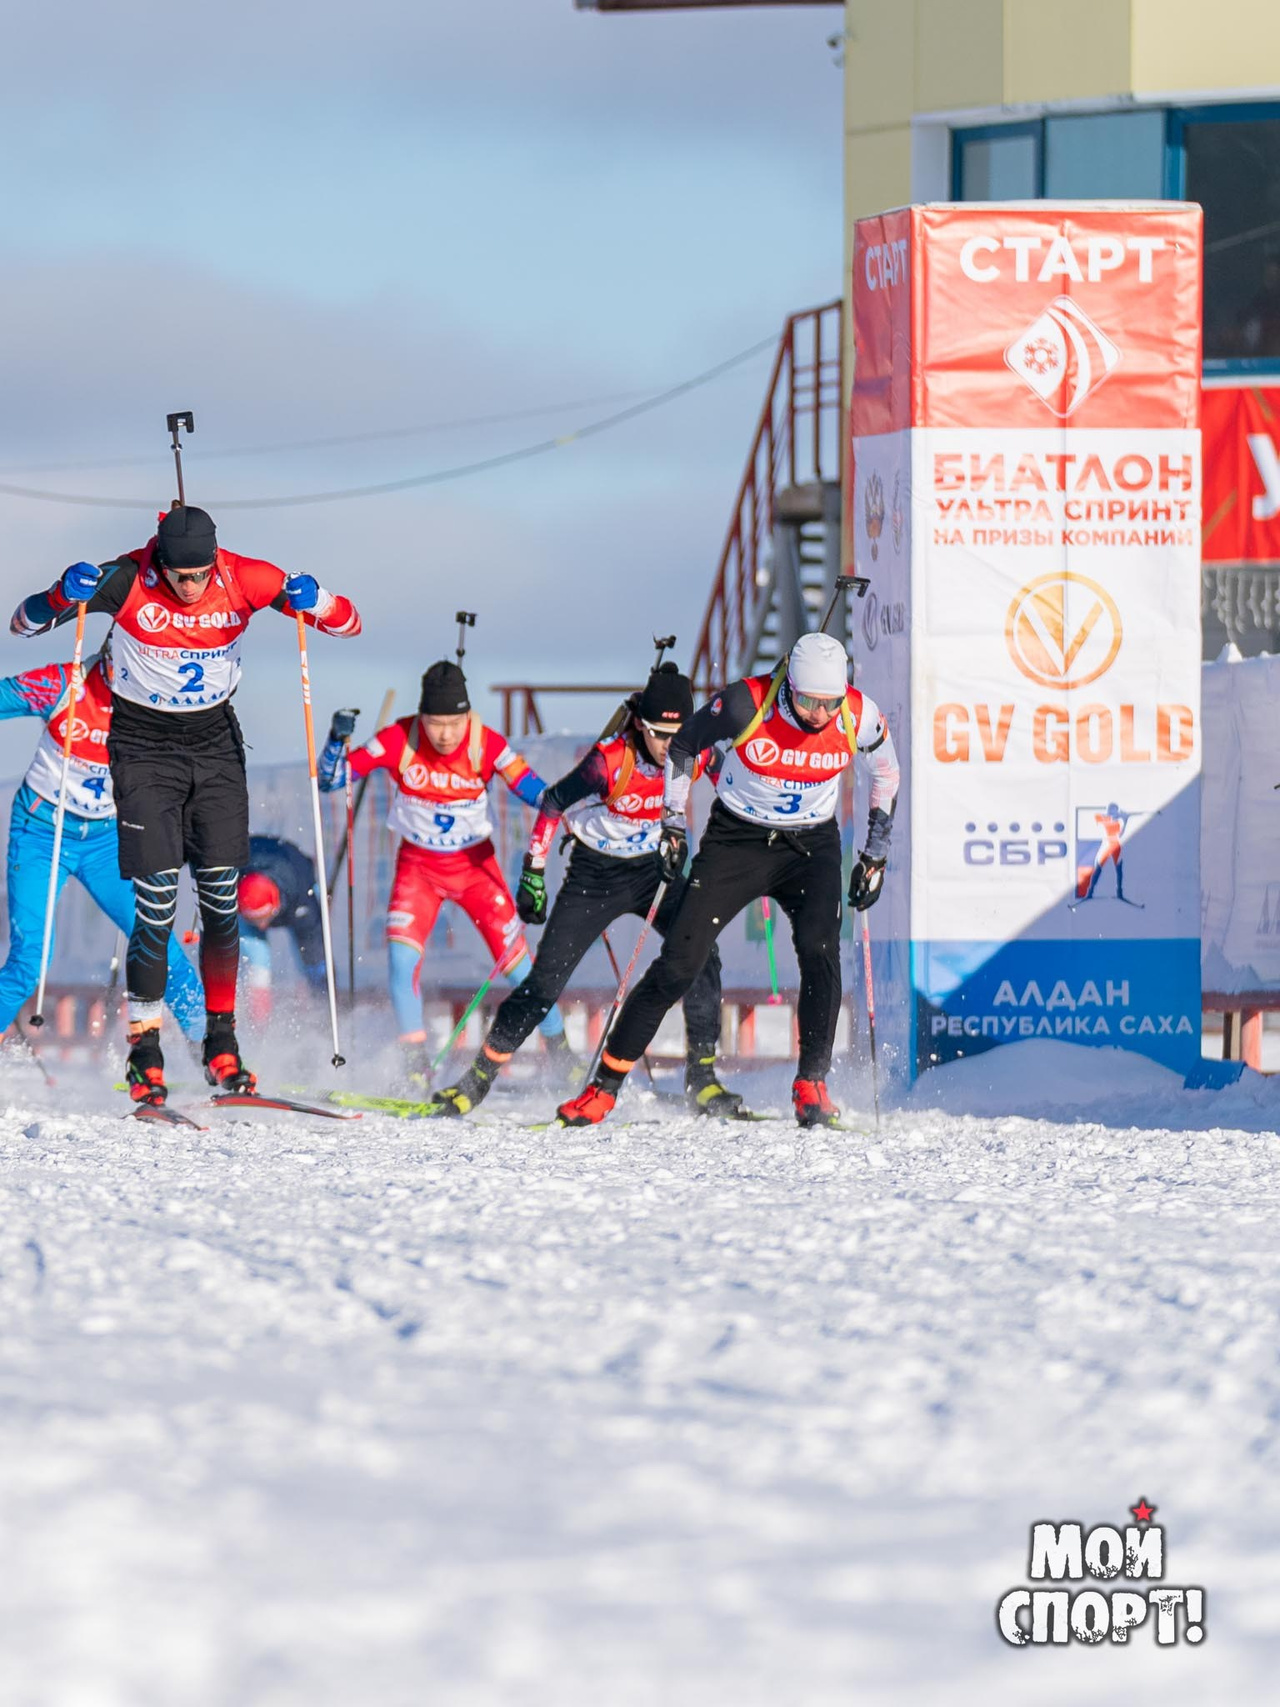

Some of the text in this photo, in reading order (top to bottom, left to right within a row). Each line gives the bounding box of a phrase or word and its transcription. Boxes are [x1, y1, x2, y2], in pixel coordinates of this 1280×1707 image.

[864, 238, 908, 292] СТАРТ
[959, 235, 1165, 284] СТАРТ
[932, 453, 1193, 493] БИАТЛОН
[934, 498, 1192, 523] УЛЬТРА СПРИНТ
[933, 528, 1194, 547] НА ПРИЗЫ КОМПАНИИ
[172, 610, 242, 629] GV GOLD
[120, 667, 129, 681] 2
[177, 661, 206, 693] 2
[932, 702, 1195, 764] GV GOLD
[780, 748, 850, 770] GV GOLD
[81, 777, 106, 800] 4
[429, 771, 449, 789] GV
[773, 792, 803, 815] 3
[433, 813, 456, 834] 9
[963, 838, 1068, 866] СБР
[992, 979, 1131, 1013] АЛДАН
[930, 1014, 1194, 1037] РЕСПУБЛИКА САХА
